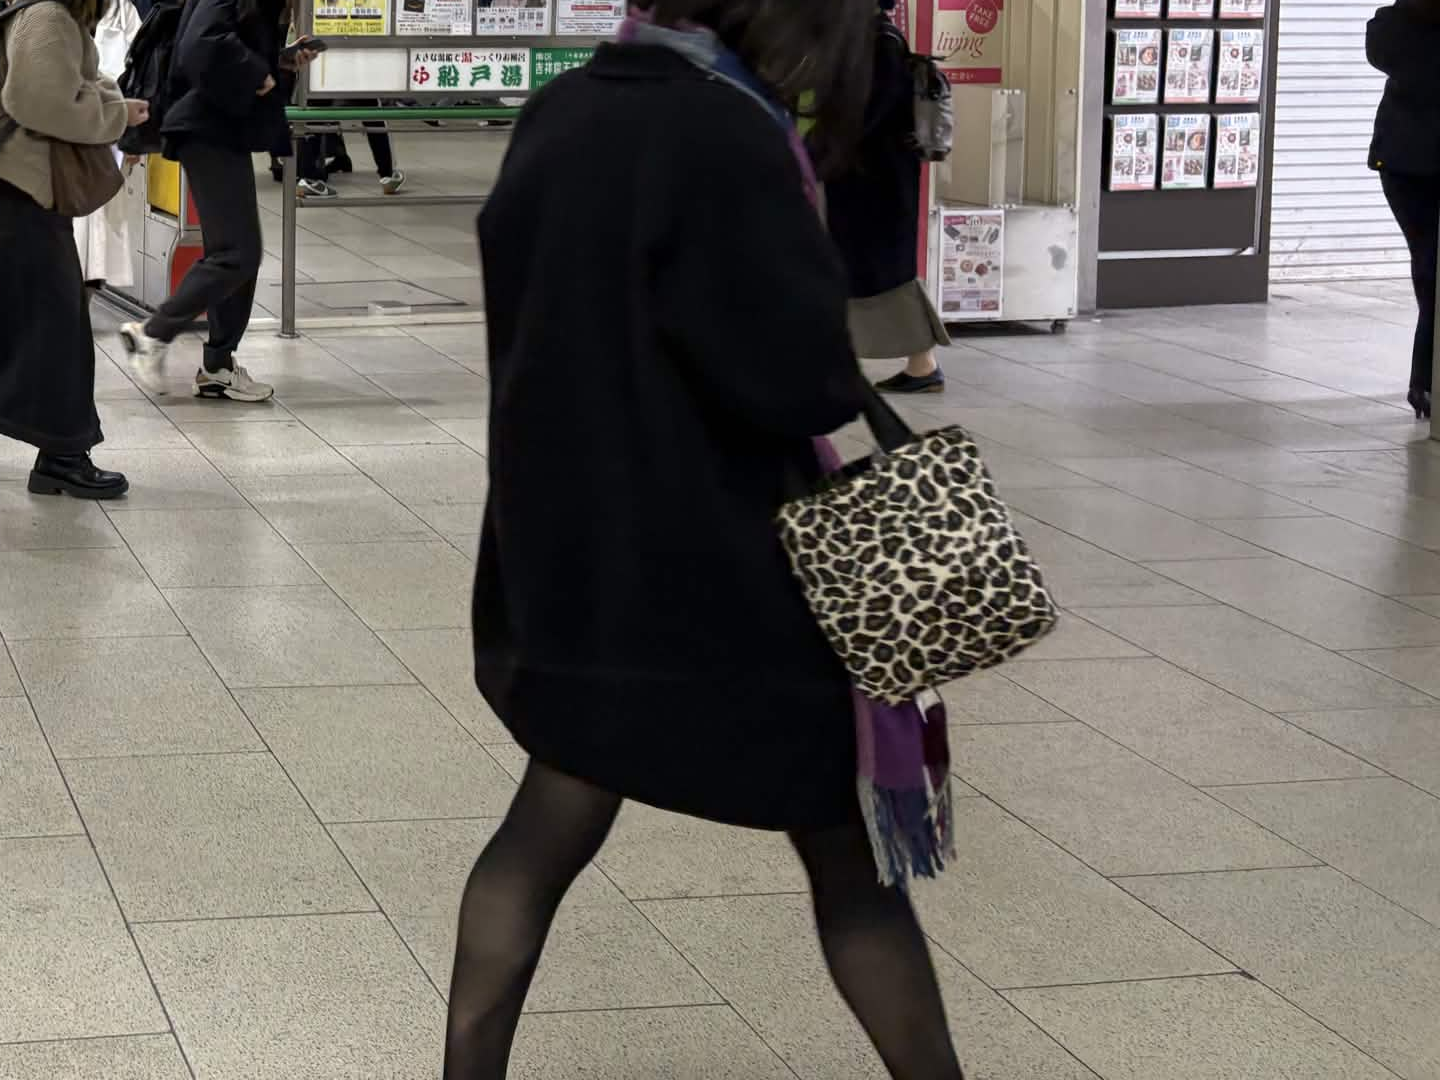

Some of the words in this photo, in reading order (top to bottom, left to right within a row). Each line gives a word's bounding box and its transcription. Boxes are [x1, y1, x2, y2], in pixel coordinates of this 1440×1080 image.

[936, 31, 985, 58] living
[437, 64, 523, 88] 船戸湯
